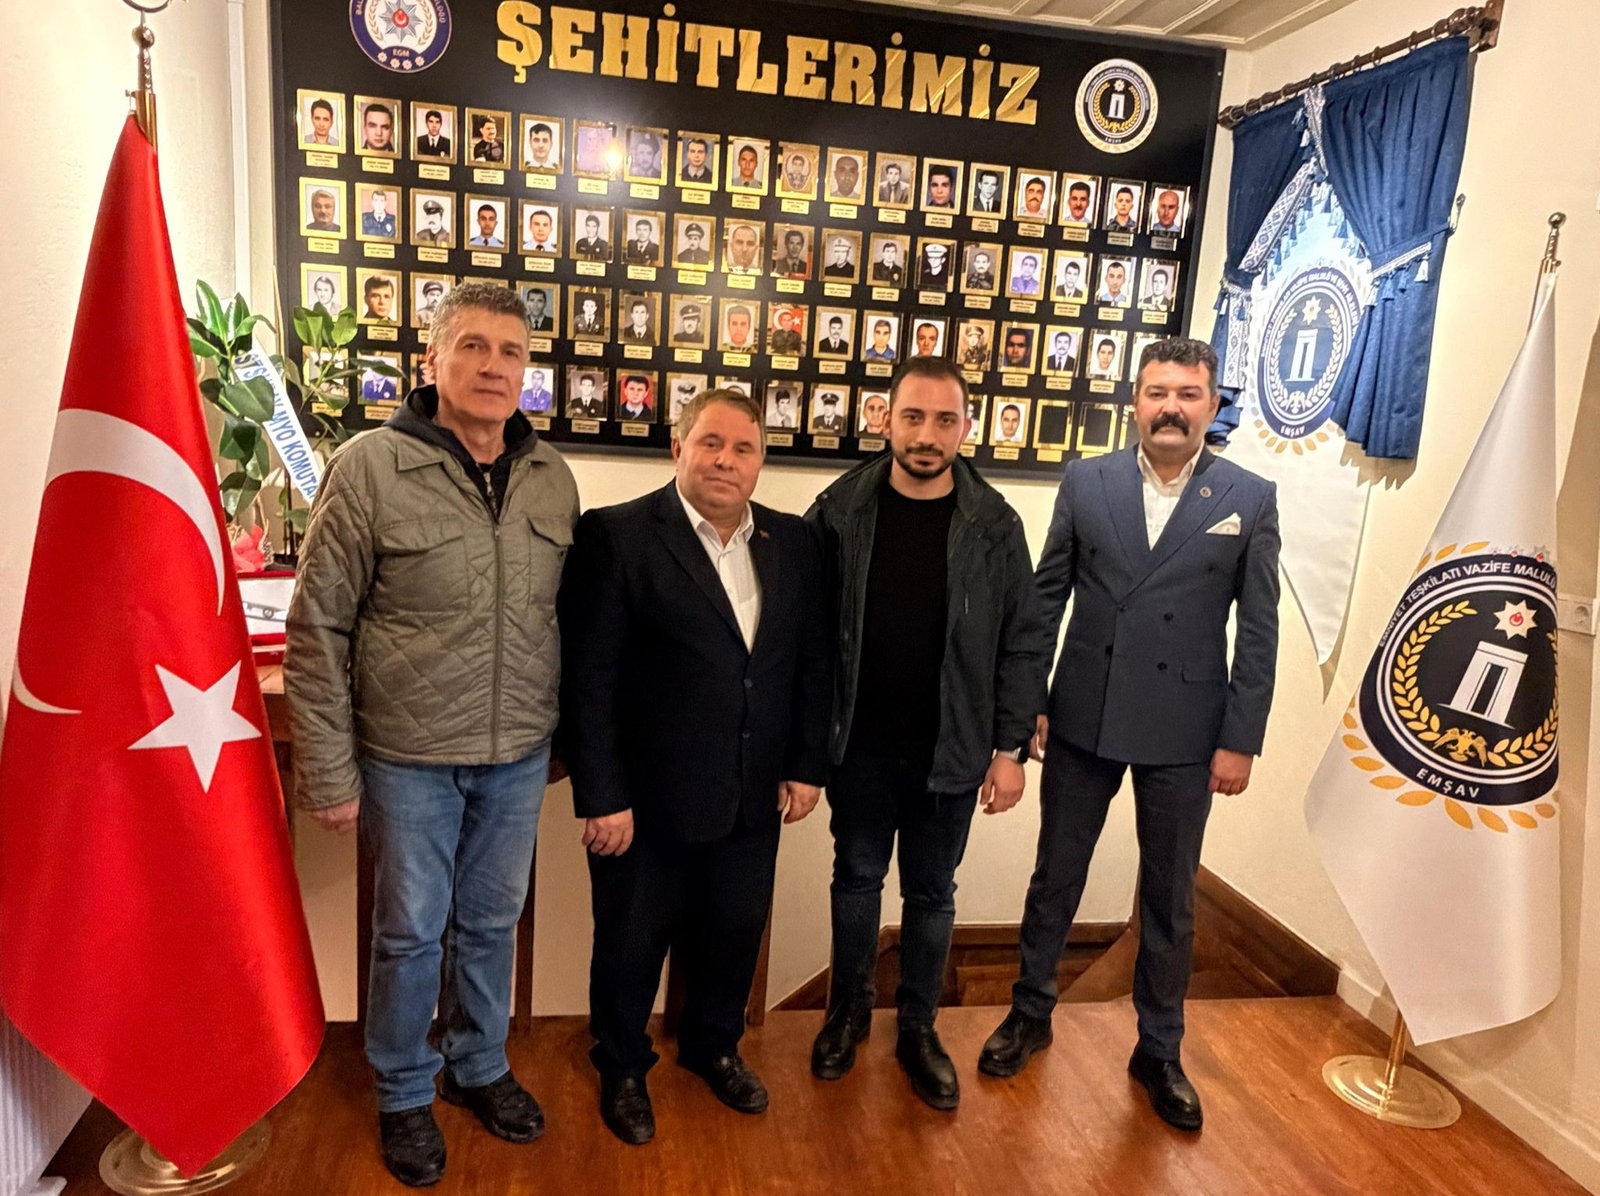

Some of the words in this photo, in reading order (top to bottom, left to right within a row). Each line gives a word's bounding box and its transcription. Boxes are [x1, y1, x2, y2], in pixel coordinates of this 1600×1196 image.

[497, 0, 1040, 126] ŞEHİTLERİMİZ
[269, 409, 297, 441] MYO
[281, 438, 319, 498] KOMUTA
[1405, 567, 1462, 603] TEŞKİLATI
[1462, 560, 1511, 576] VAZİFE
[1416, 767, 1480, 798] EMŞAV
